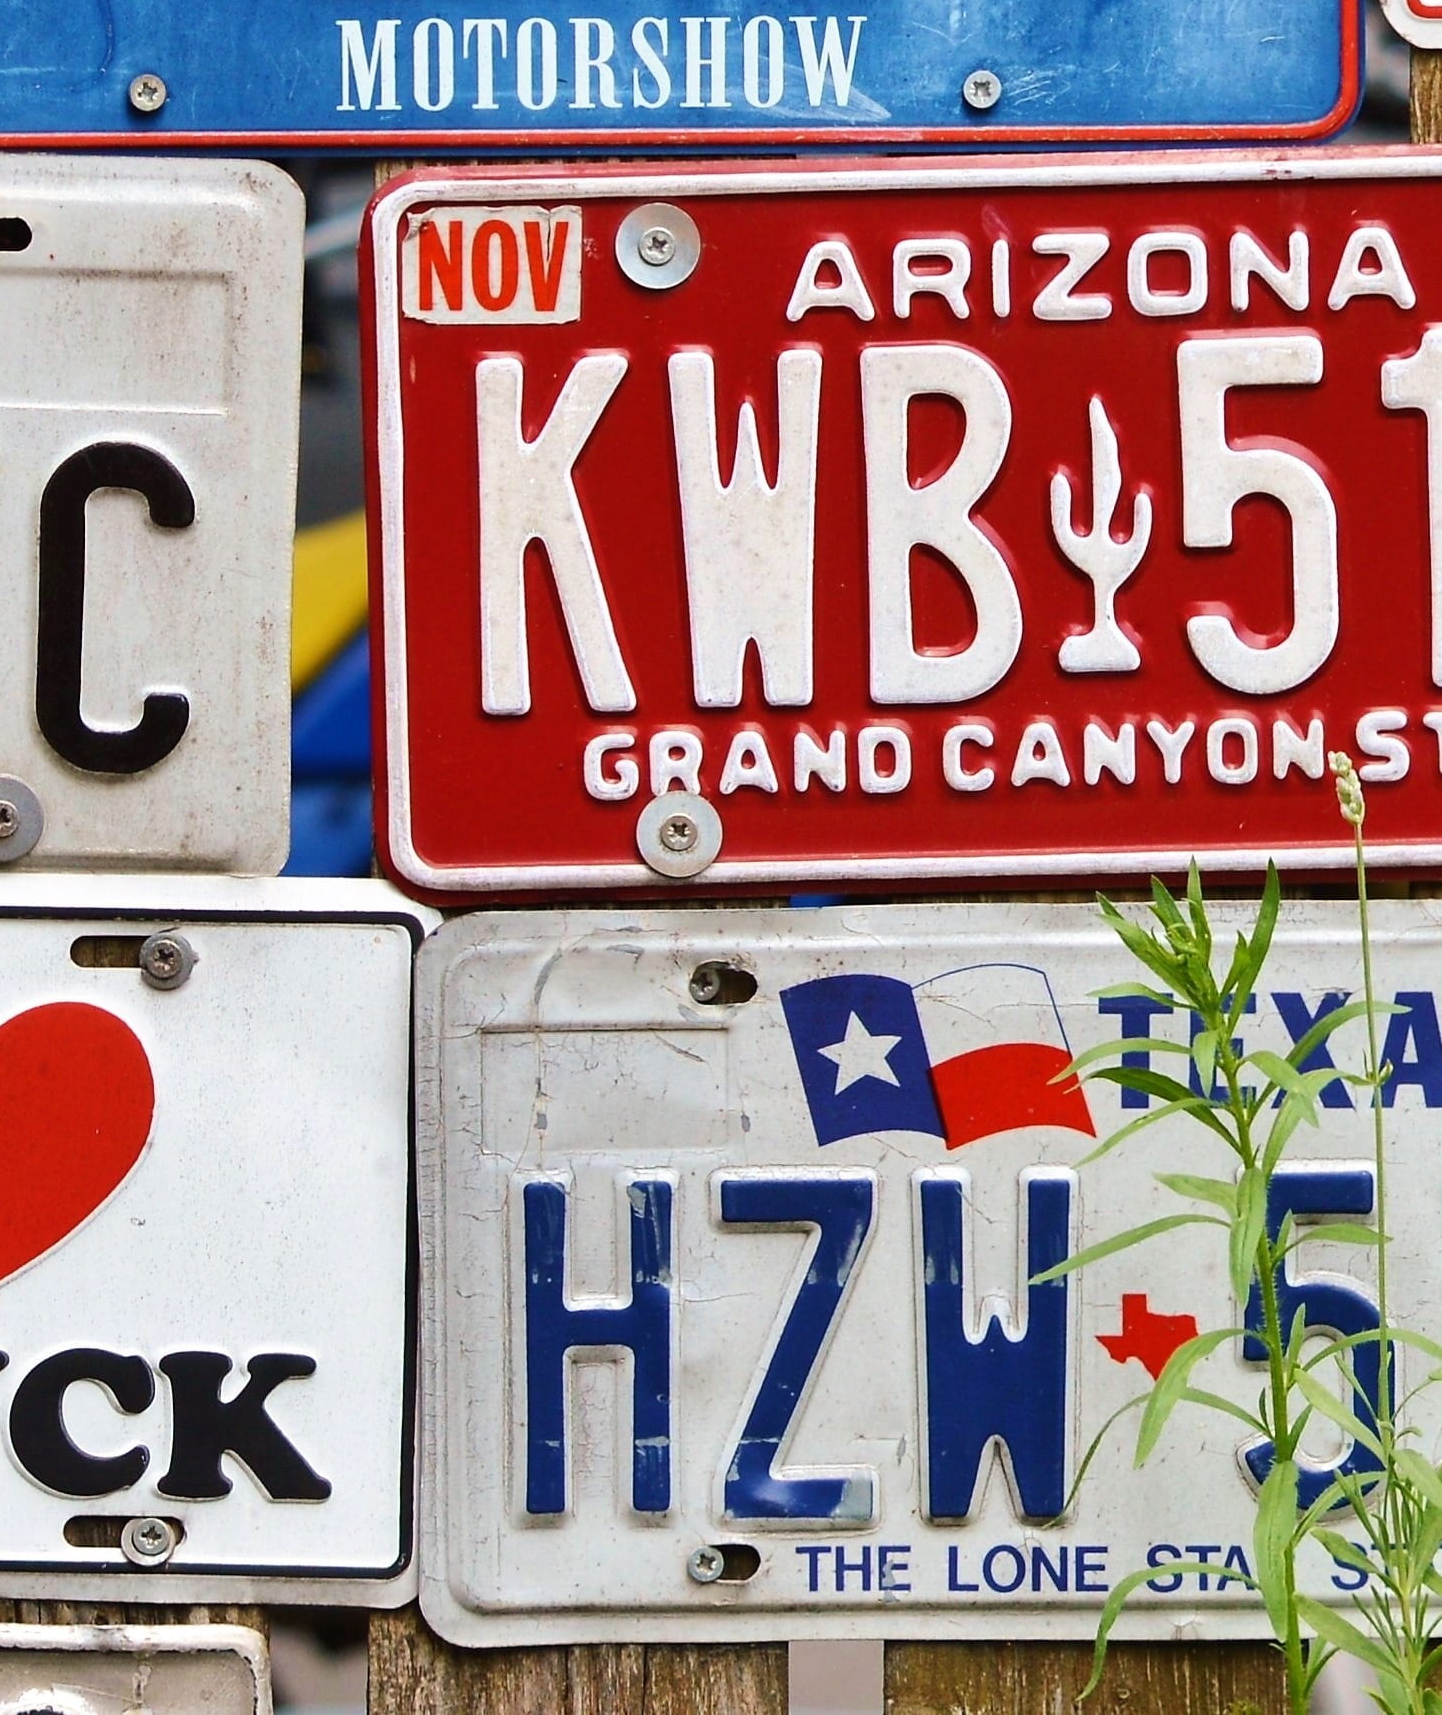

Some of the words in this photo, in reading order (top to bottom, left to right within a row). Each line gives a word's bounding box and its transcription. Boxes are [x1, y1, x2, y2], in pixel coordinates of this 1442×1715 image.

[336, 16, 869, 111] MOTORSHOW
[417, 219, 569, 312] NOV
[787, 224, 1416, 326] ARIZONA
[476, 341, 1022, 714] KWB
[583, 729, 912, 804] GRAND
[943, 715, 1326, 789] CANYON
[523, 1180, 1071, 1522] HZW
[796, 1546, 911, 1591] THE
[949, 1545, 1109, 1593] LONE
[1146, 1544, 1259, 1593] STA
